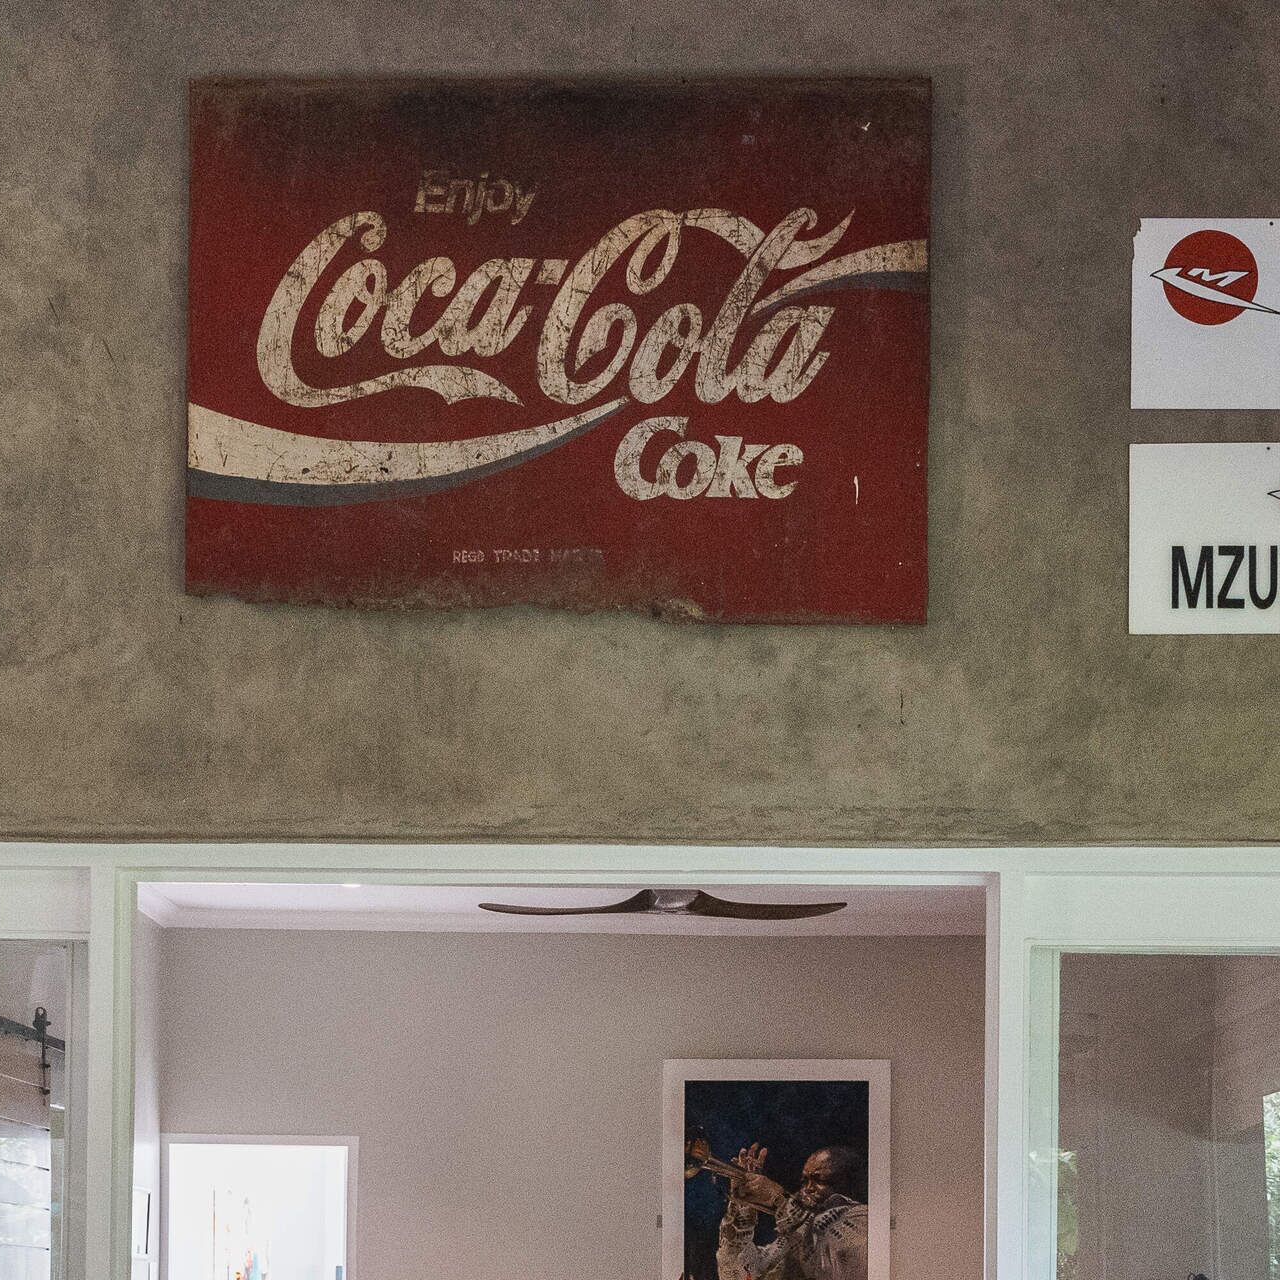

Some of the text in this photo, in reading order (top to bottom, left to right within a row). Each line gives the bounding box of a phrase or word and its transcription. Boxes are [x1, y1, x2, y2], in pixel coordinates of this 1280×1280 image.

[413, 171, 537, 226] Enjoy
[256, 206, 855, 409] Coca-Cola
[614, 416, 806, 501] Coke
